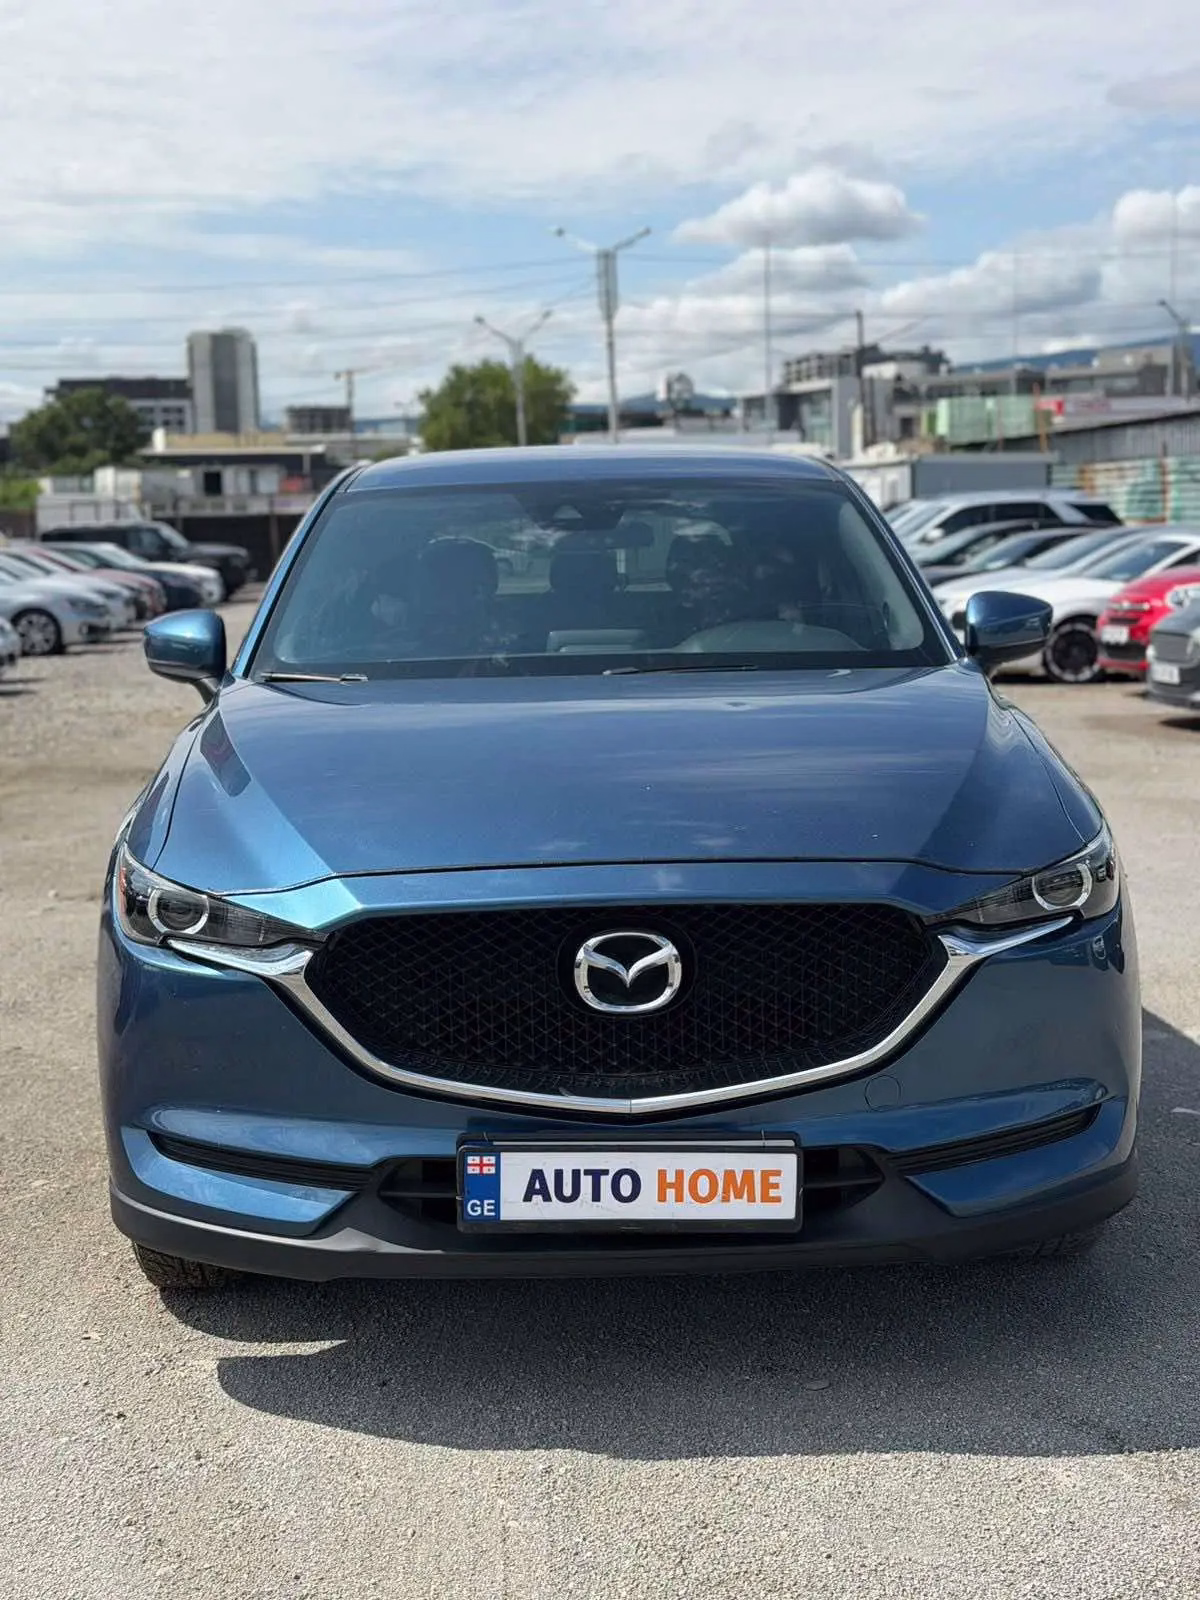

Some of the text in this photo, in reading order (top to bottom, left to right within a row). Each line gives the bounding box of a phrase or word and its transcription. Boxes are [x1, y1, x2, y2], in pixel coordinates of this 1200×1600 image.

[522, 1168, 783, 1204] AUTO HOME
[466, 1199, 496, 1216] GE
